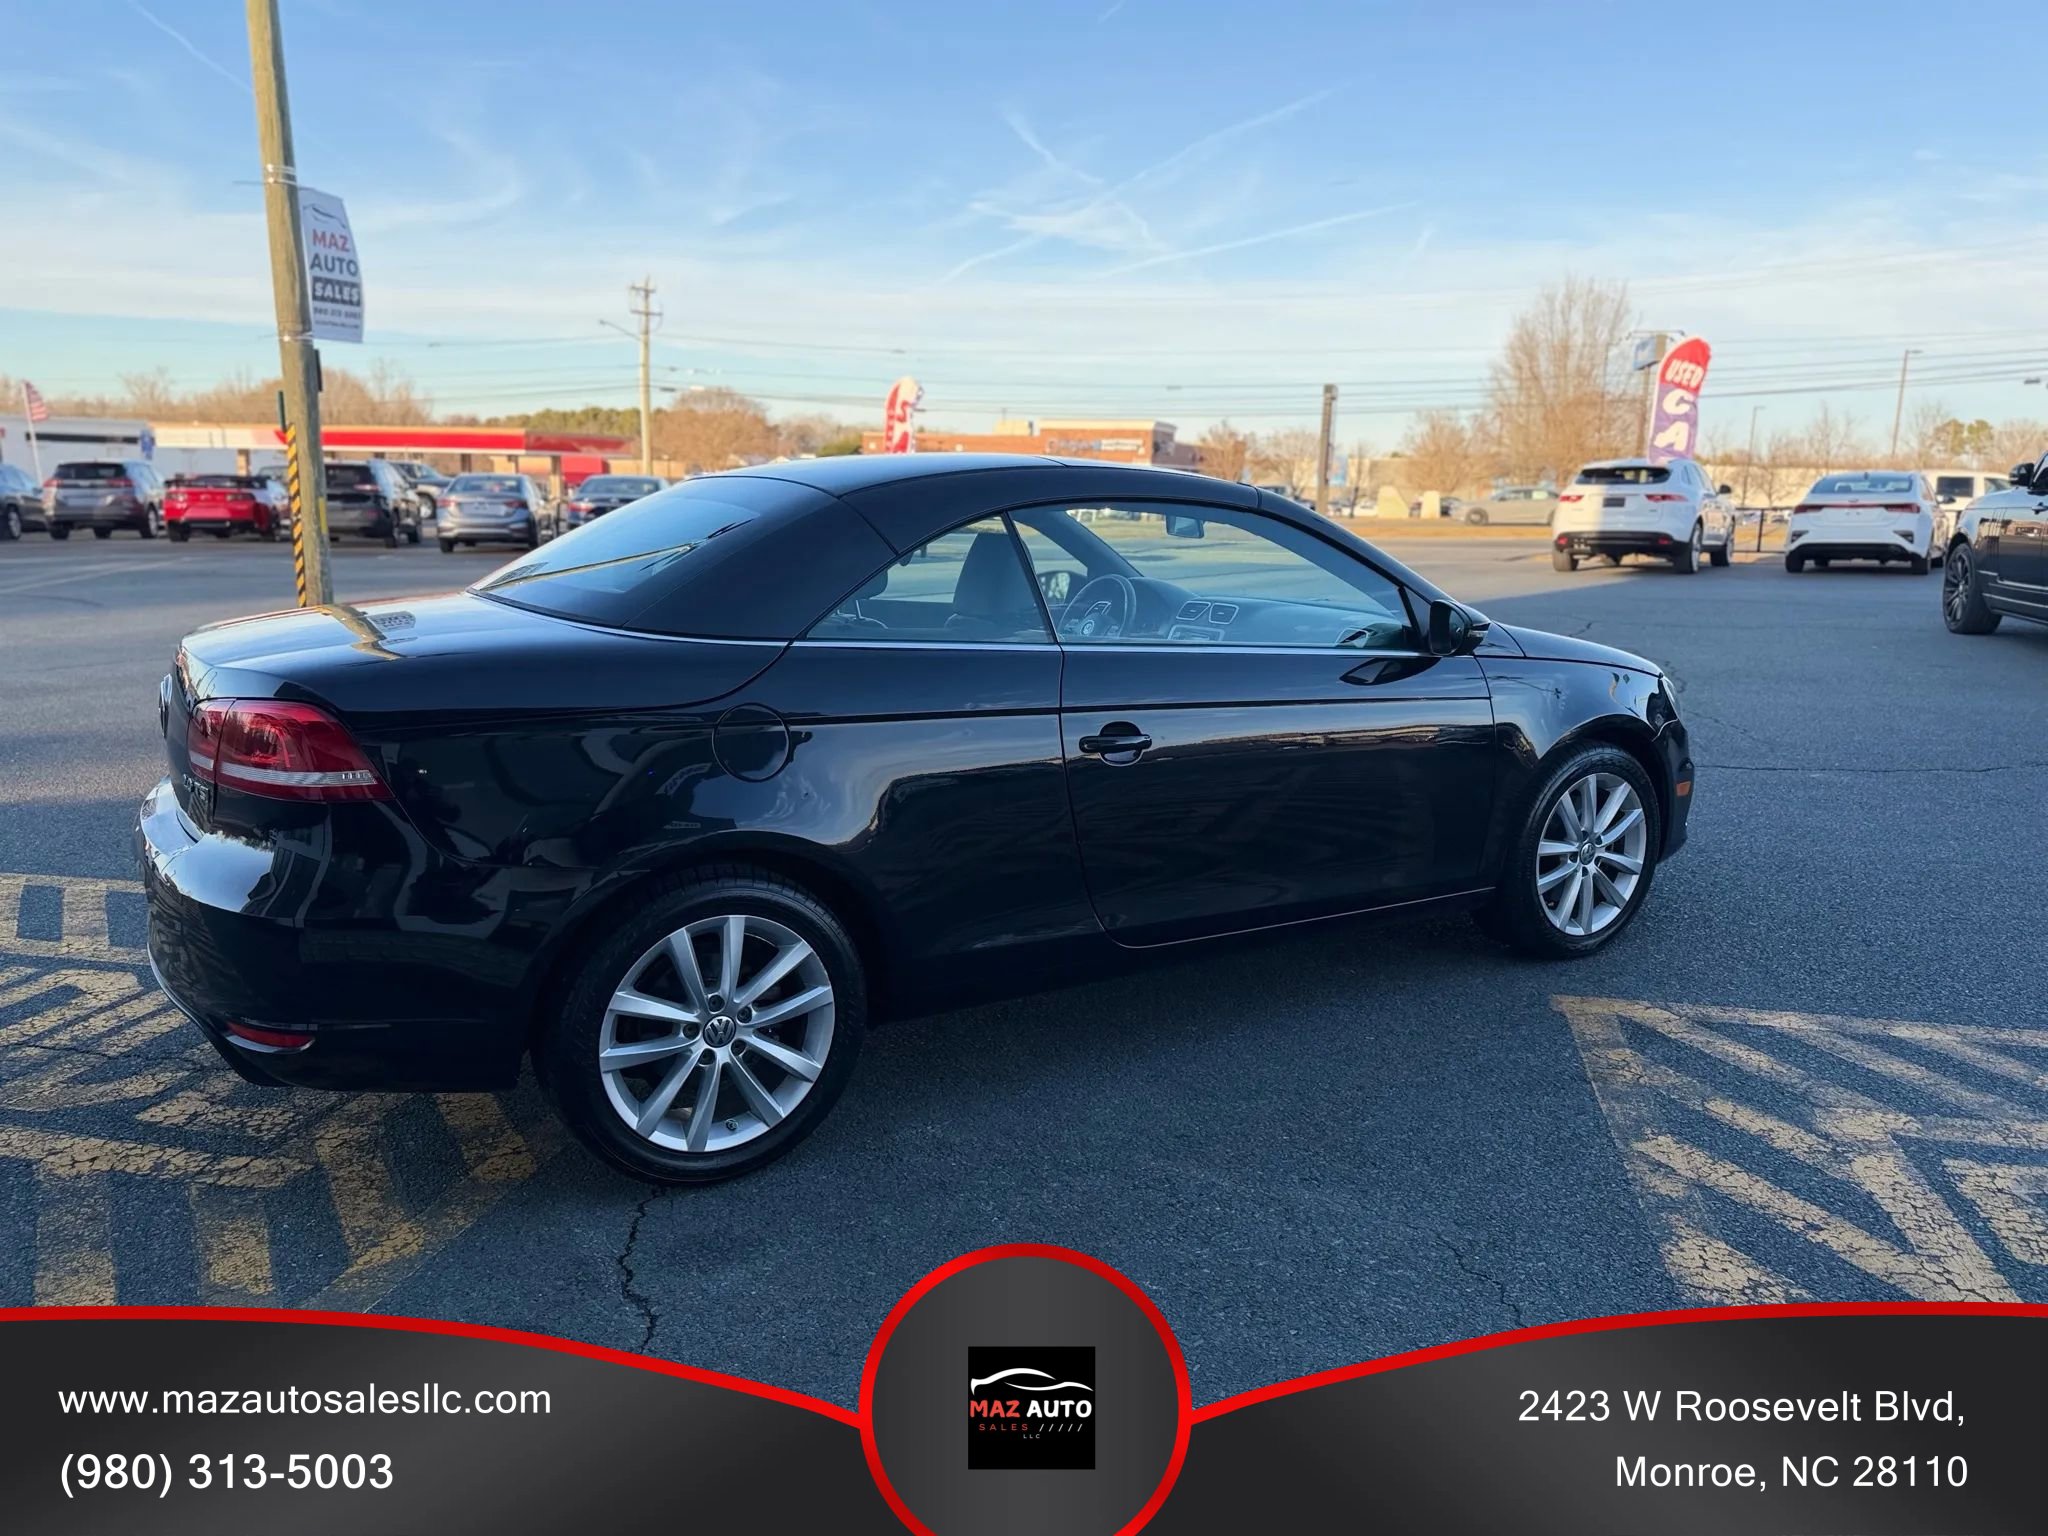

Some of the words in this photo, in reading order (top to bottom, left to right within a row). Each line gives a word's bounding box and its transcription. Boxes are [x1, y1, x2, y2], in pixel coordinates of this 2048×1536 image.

[312, 229, 350, 252] MAZ
[310, 253, 359, 277] AUTO
[314, 281, 360, 305] SALES
[1664, 358, 1705, 389] USED
[1653, 388, 1697, 465] CA
